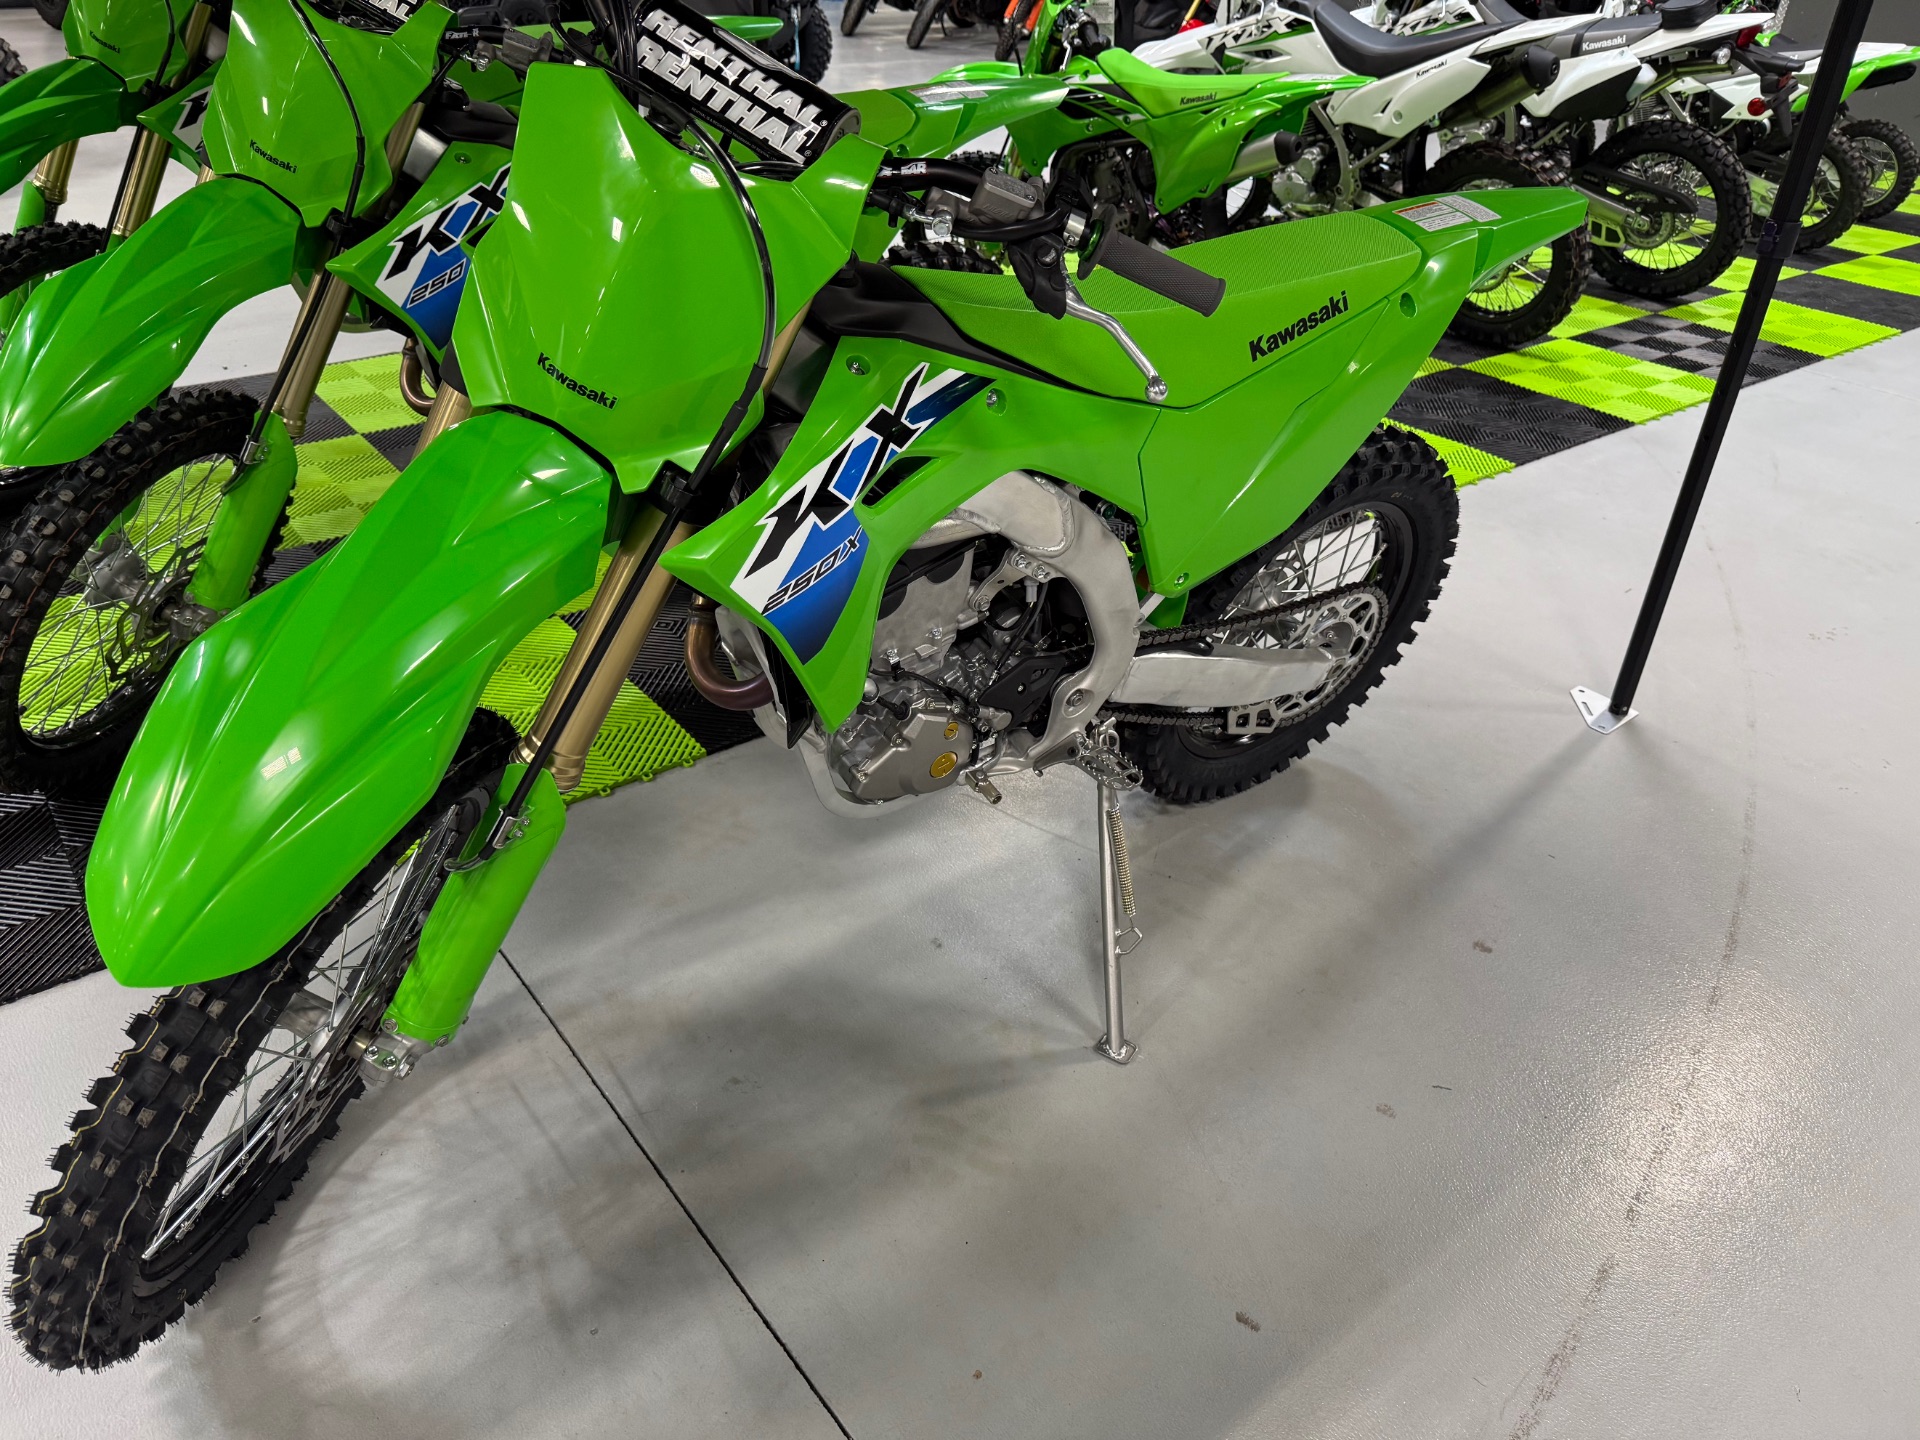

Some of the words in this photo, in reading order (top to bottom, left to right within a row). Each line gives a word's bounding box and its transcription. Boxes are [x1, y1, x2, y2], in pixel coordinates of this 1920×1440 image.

[90, 31, 120, 53] Kawasaki
[1583, 34, 1626, 51] Kawasaki
[636, 35, 807, 164] RENTHAL
[1180, 91, 1217, 106] Kawasaki
[250, 139, 297, 174] Kawasaki
[407, 258, 466, 308] 250
[1249, 290, 1349, 362] Kawasaki
[537, 352, 617, 408] Kawasaki
[744, 364, 927, 579] KX
[761, 525, 863, 616] 250X
